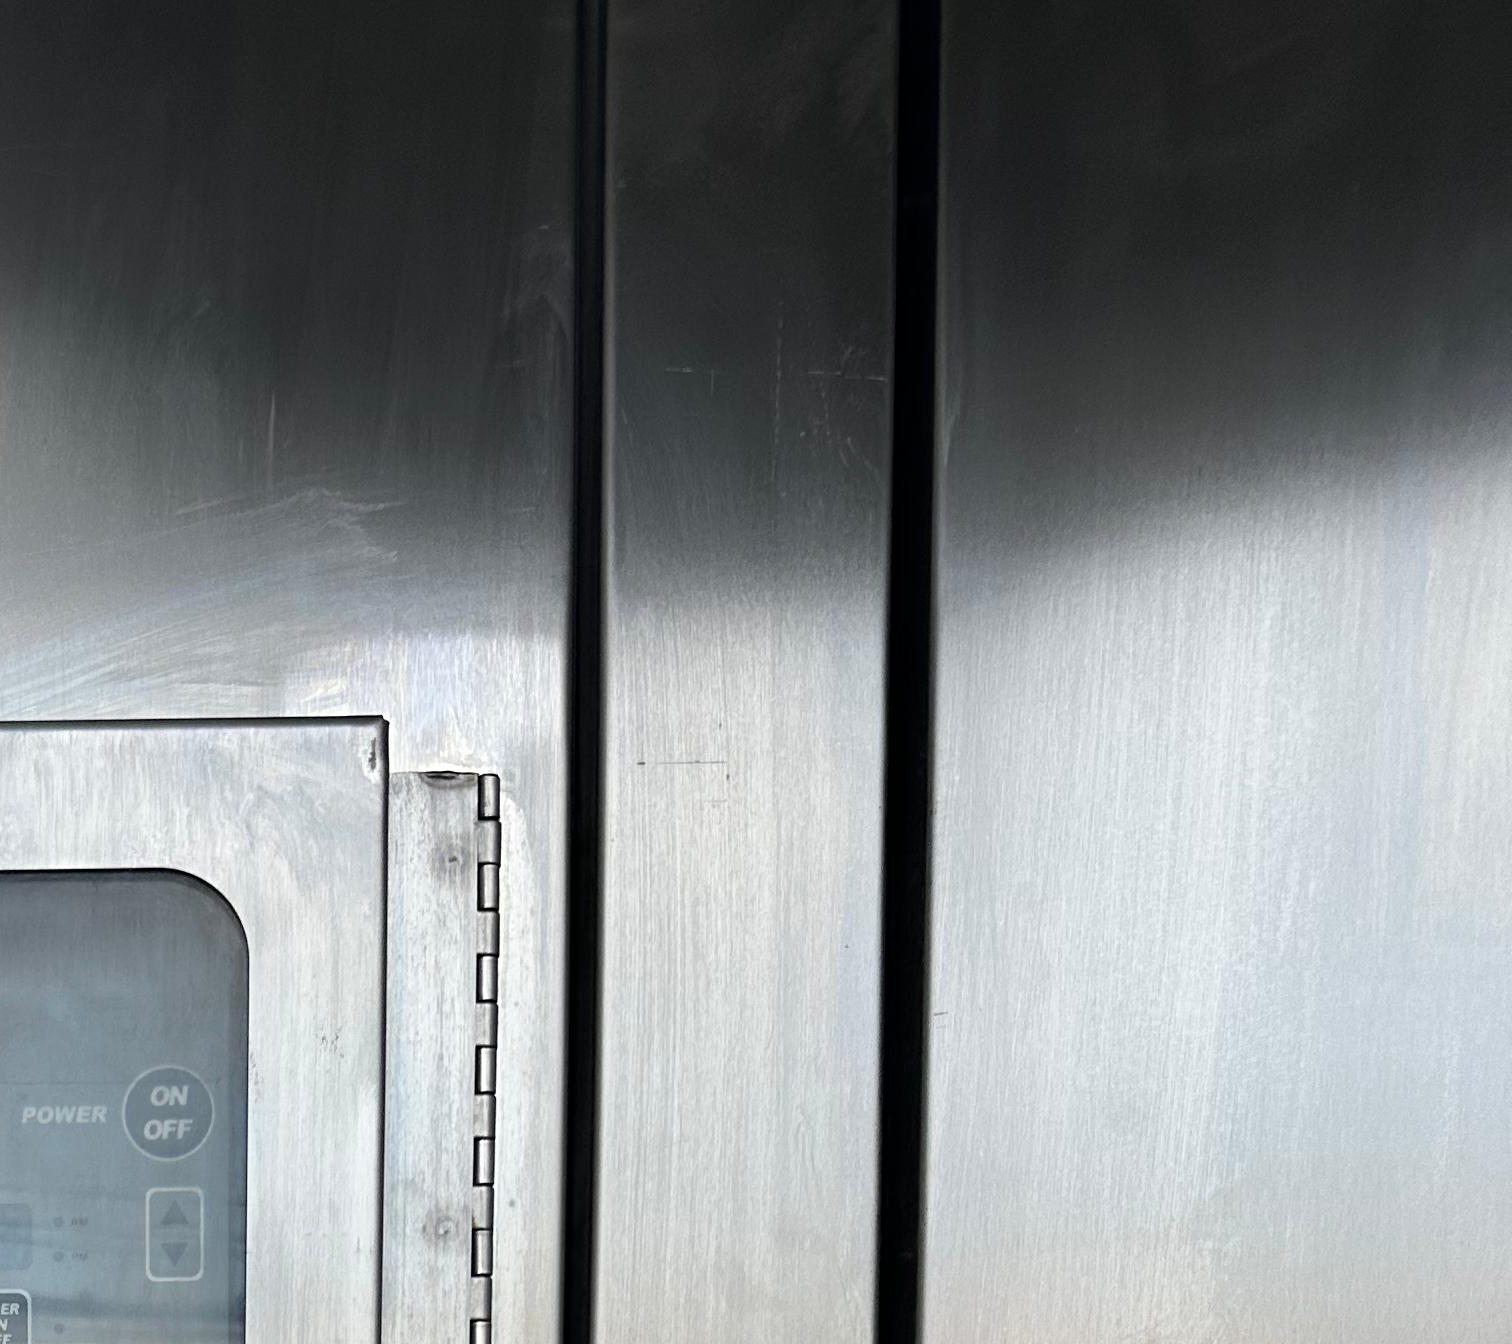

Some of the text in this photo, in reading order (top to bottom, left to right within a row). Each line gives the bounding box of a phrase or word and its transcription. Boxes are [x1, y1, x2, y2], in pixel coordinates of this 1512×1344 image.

[150, 1085, 188, 1107] ON
[21, 1106, 107, 1125] POWER
[143, 1119, 193, 1141] OFF
